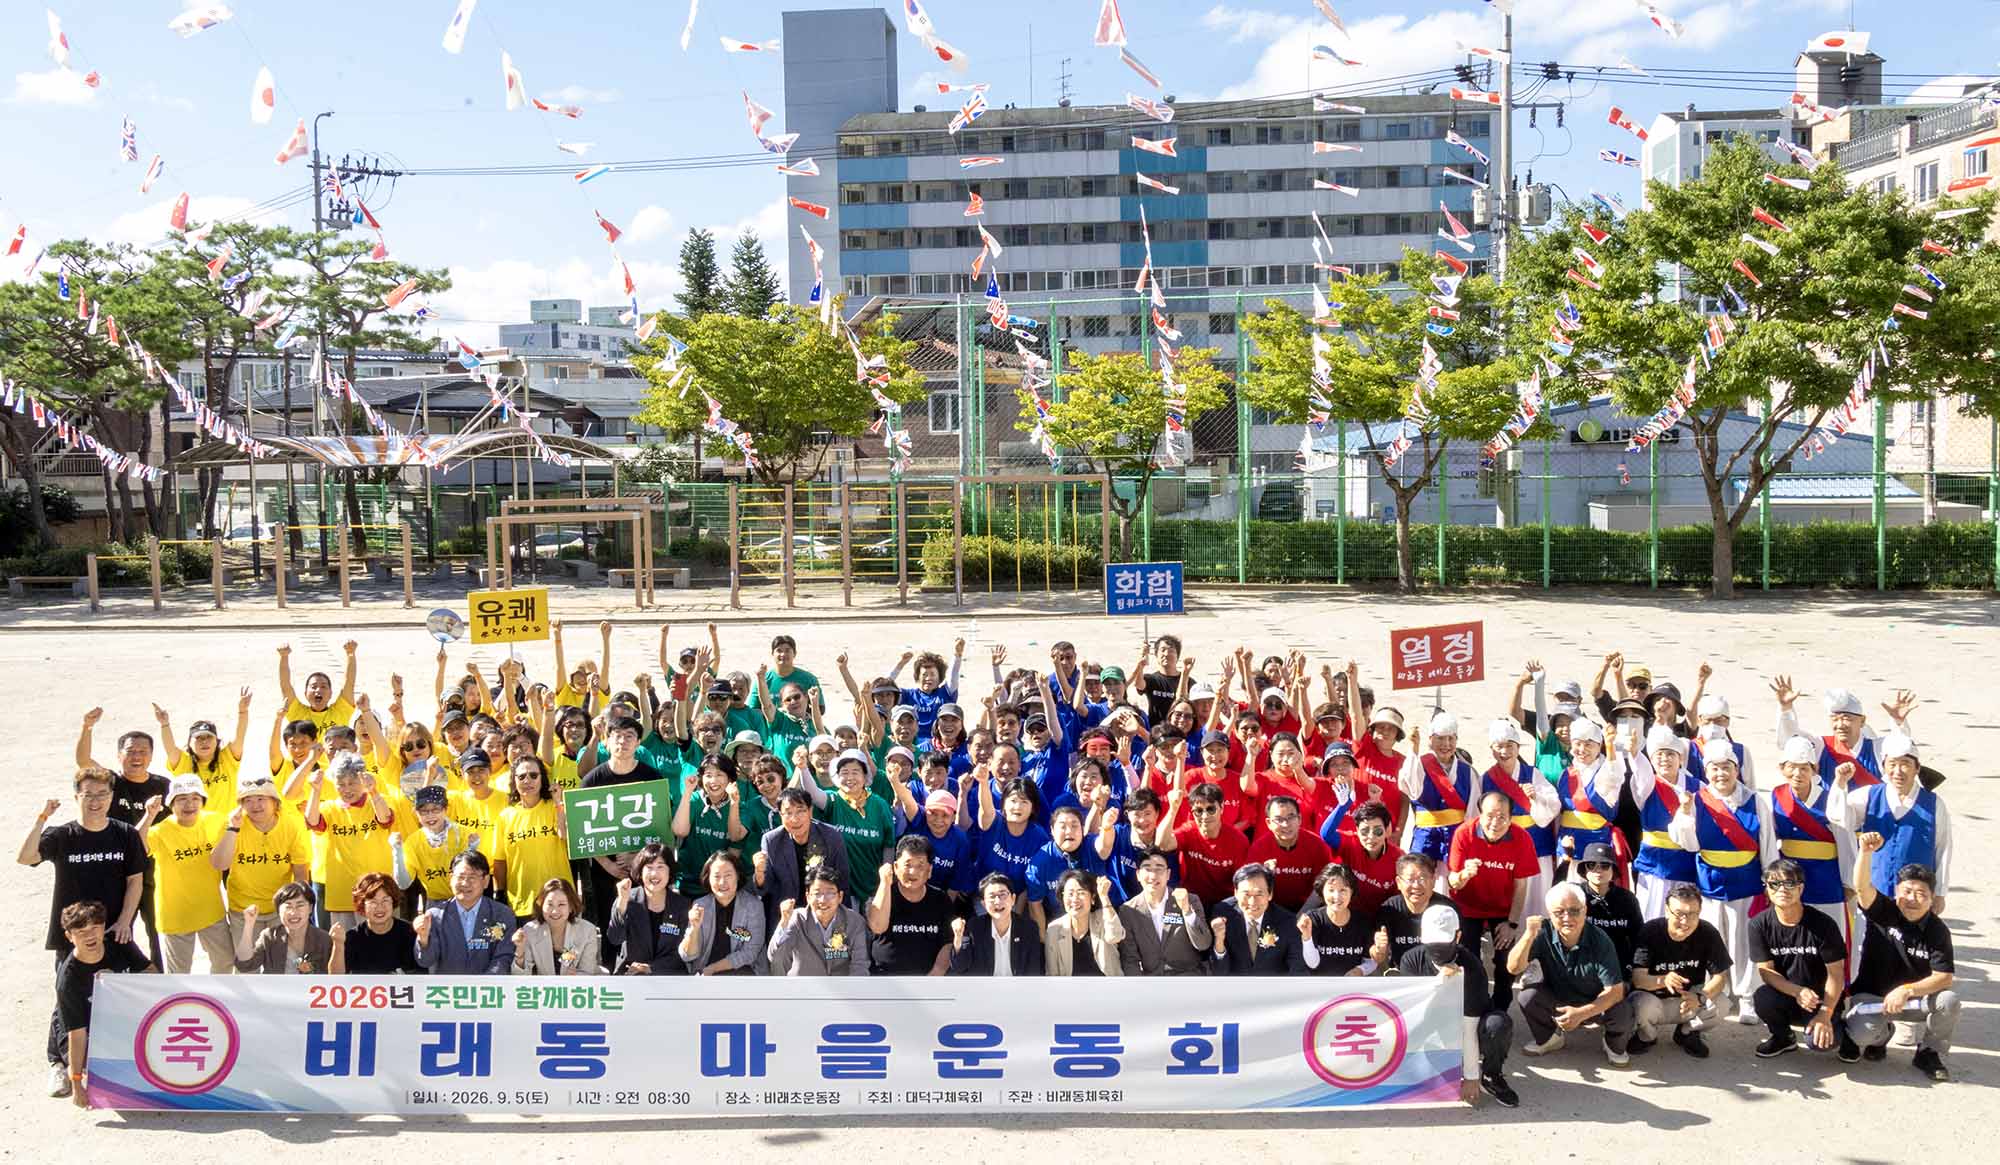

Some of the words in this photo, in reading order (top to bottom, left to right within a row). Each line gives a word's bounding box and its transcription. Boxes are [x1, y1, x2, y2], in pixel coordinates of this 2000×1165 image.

[1114, 569, 1174, 597] 화합
[476, 596, 535, 627] 유쾌
[1400, 630, 1473, 668] 열정
[575, 792, 657, 835] 건강
[174, 847, 202, 861] 웃다가
[577, 836, 595, 854] 우린
[599, 835, 617, 851] 아직
[237, 853, 268, 864] 웃다가
[310, 984, 414, 1009] 2026년
[425, 985, 506, 1010] 주민과
[515, 985, 625, 1011] 함께하는
[161, 1016, 213, 1071] 축
[304, 1020, 611, 1079] 비래동
[700, 1020, 1240, 1080] 마을운동회
[1328, 1014, 1381, 1064] 축
[412, 1091, 438, 1105] 일시
[451, 1091, 493, 1105] 2026.
[515, 1091, 549, 1105] 5(토)
[577, 1091, 601, 1104] 시간
[615, 1091, 640, 1104] 오전
[648, 1091, 690, 1105] 08:30
[725, 1091, 751, 1105] 장소
[764, 1091, 840, 1105] 비래초운동장
[867, 1091, 893, 1104] 주최
[906, 1090, 982, 1104] 대덕구체육회
[1008, 1090, 1034, 1103] 주관
[1046, 1090, 1123, 1103] 비래동체육회
